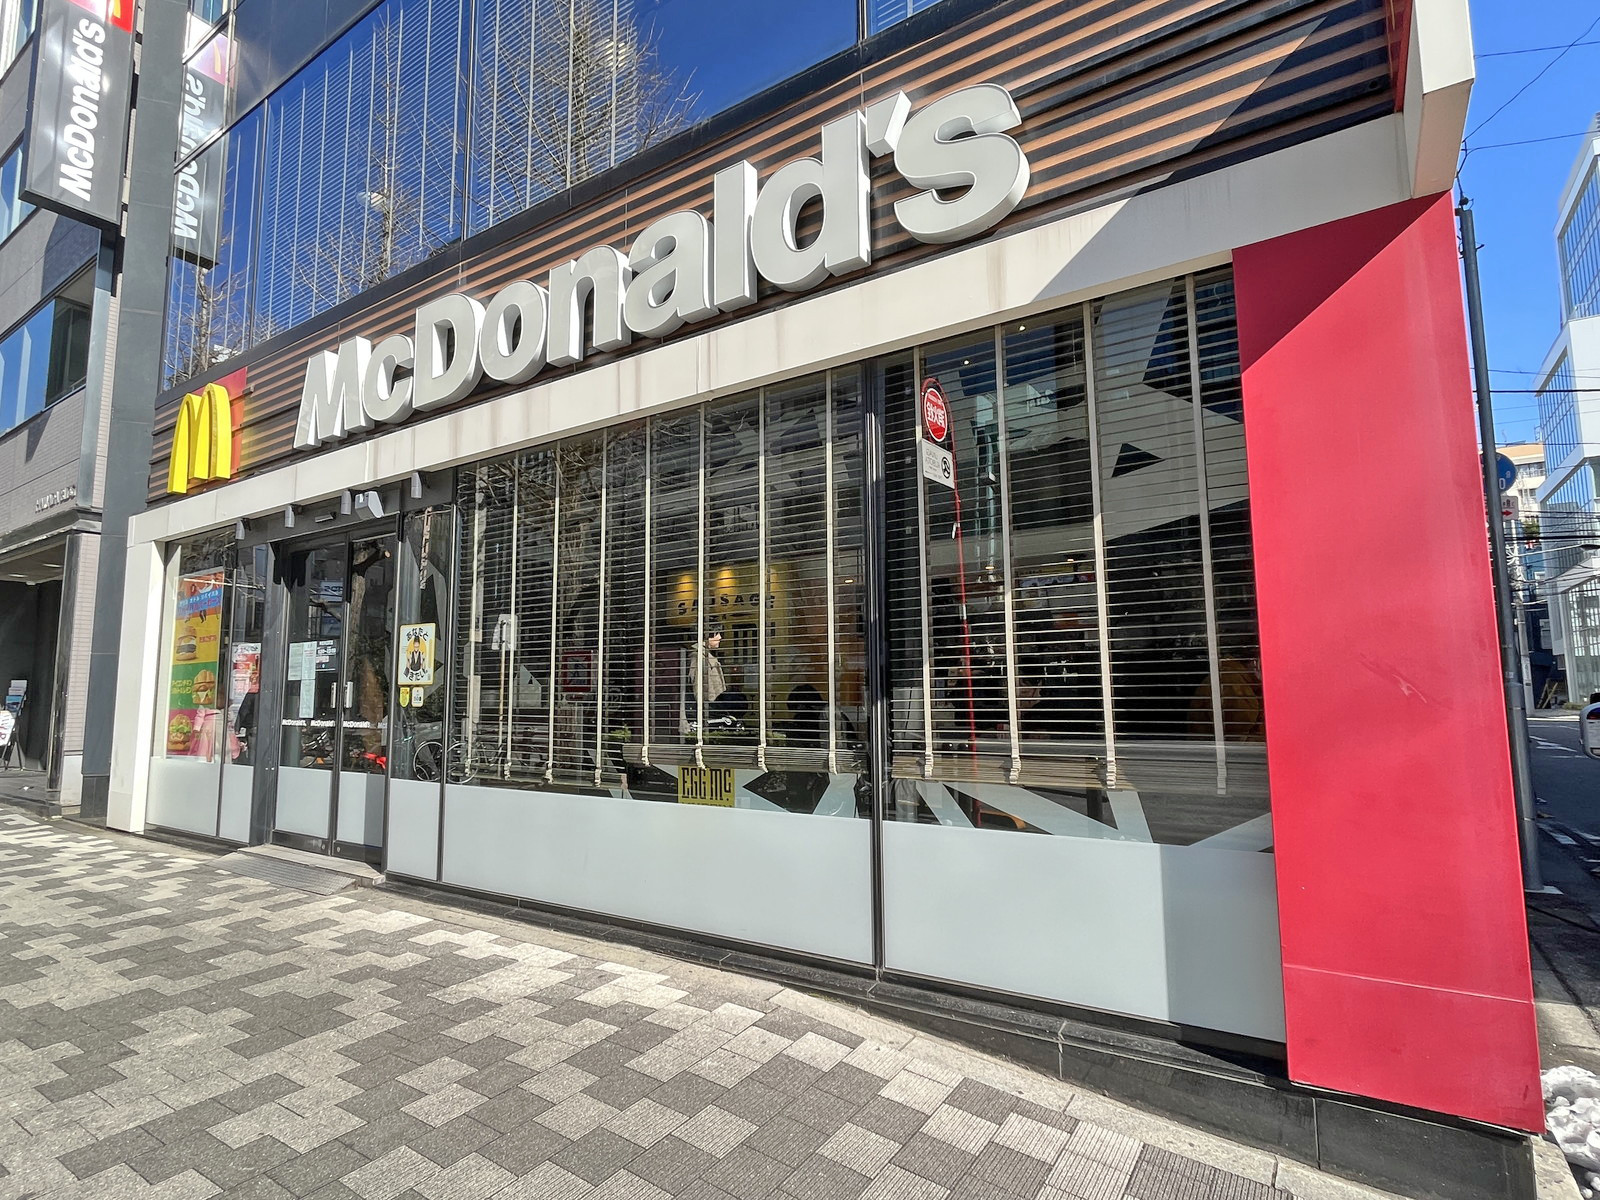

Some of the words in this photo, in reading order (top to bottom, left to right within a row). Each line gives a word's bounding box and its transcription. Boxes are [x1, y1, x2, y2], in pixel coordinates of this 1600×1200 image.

[59, 18, 106, 202] McDonald's
[293, 82, 1030, 450] McDonald's
[681, 767, 706, 800] EGG
